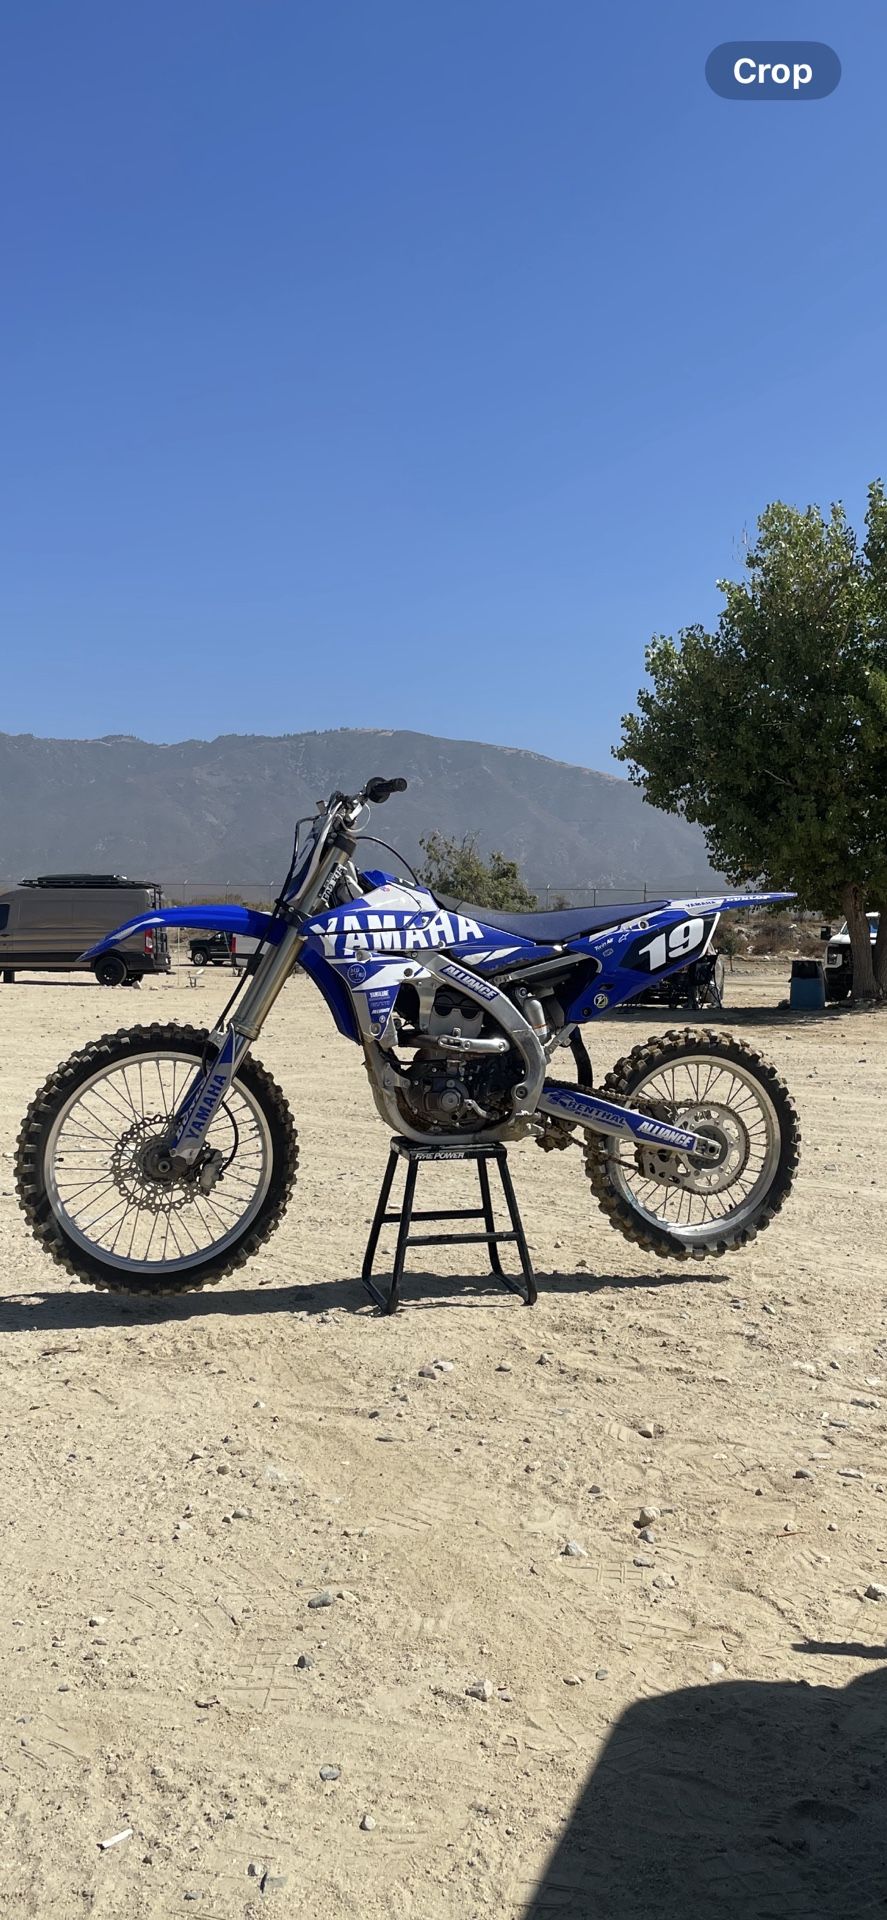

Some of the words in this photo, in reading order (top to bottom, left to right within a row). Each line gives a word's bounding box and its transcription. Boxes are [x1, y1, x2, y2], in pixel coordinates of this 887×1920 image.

[684, 900, 716, 908] YAMAHA
[309, 911, 484, 957] YAMAHA
[638, 917, 704, 972] 19
[443, 966, 499, 1001] ALLIANCE
[185, 1075, 227, 1138] YAMAHA
[568, 1099, 627, 1124] RENTHAL
[637, 1121, 694, 1147] ALLIANCE
